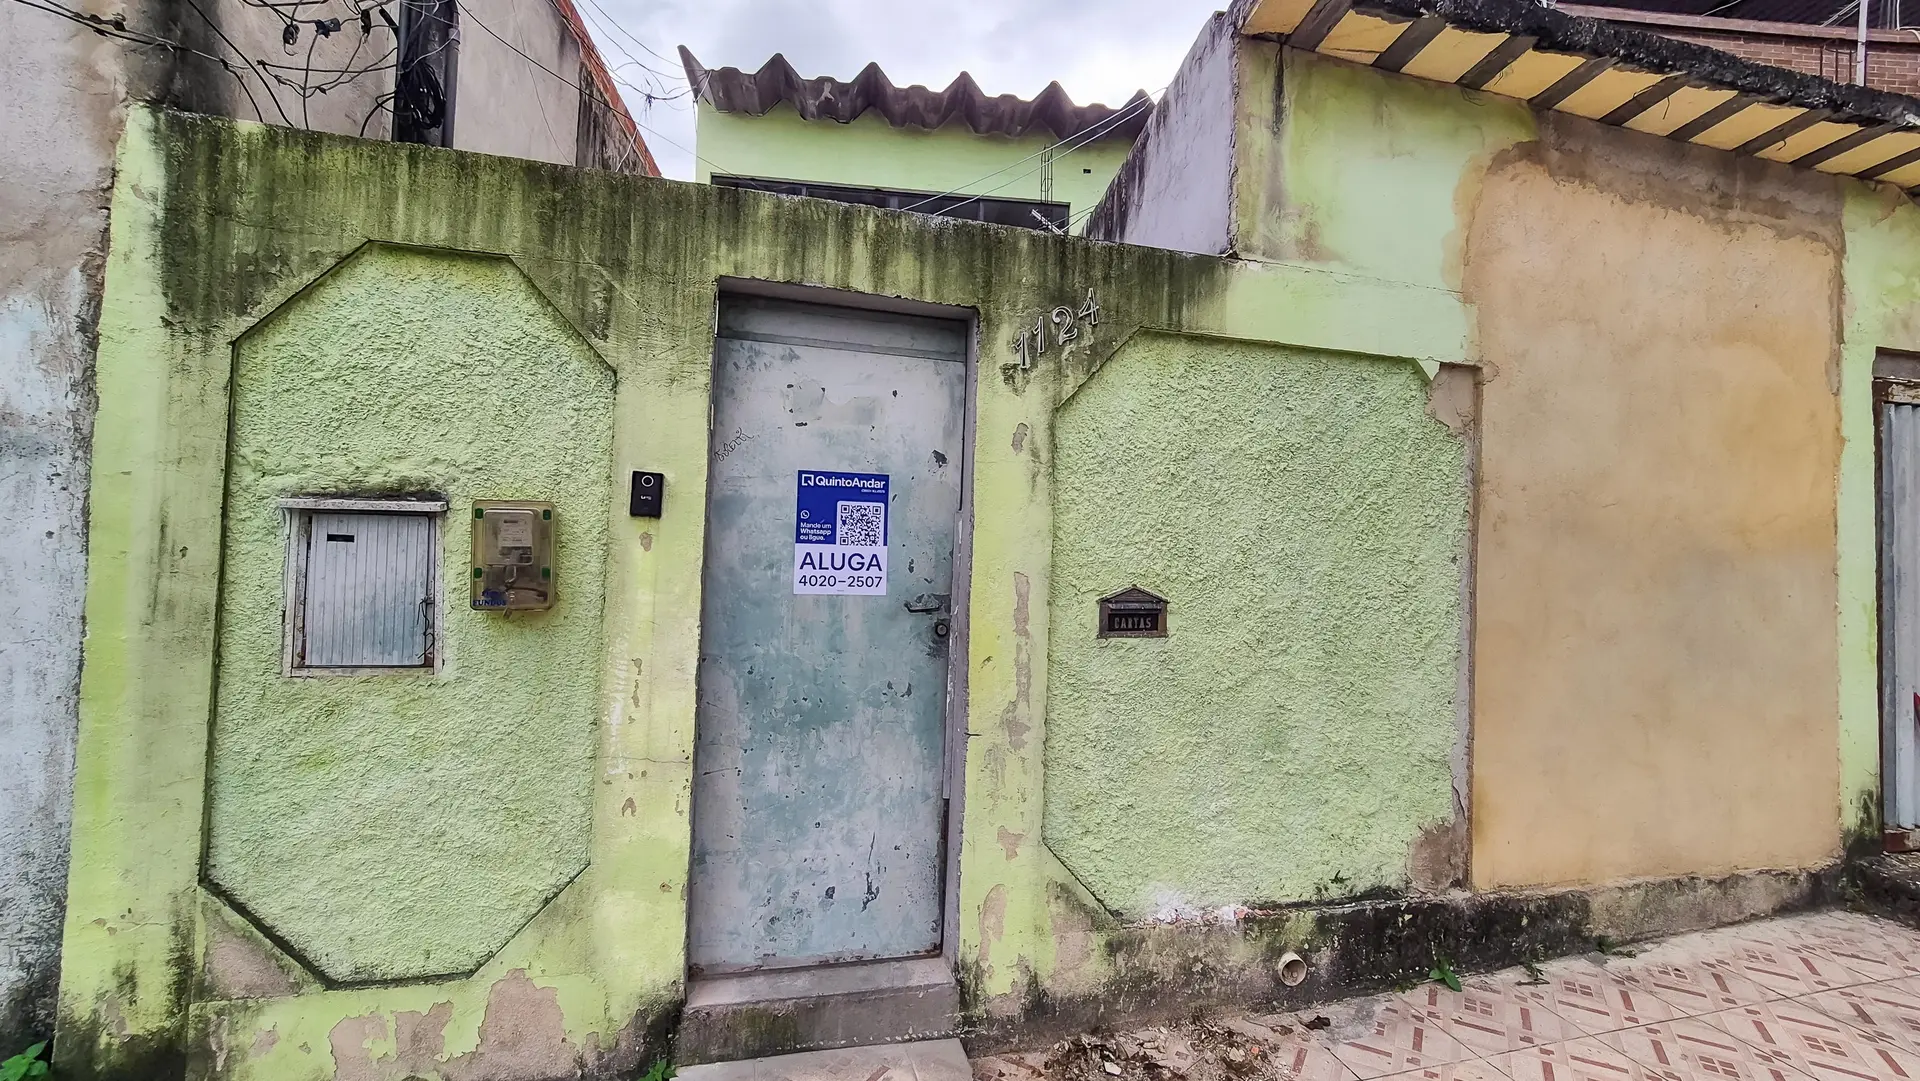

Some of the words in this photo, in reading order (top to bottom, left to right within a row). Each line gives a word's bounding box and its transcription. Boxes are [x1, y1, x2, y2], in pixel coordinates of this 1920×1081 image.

[1014, 288, 1099, 369] 1124
[815, 476, 886, 489] QuintoAndar
[799, 552, 882, 571] ALUGA
[798, 575, 883, 588] 4020-2507
[1114, 617, 1152, 629] CARTAS
